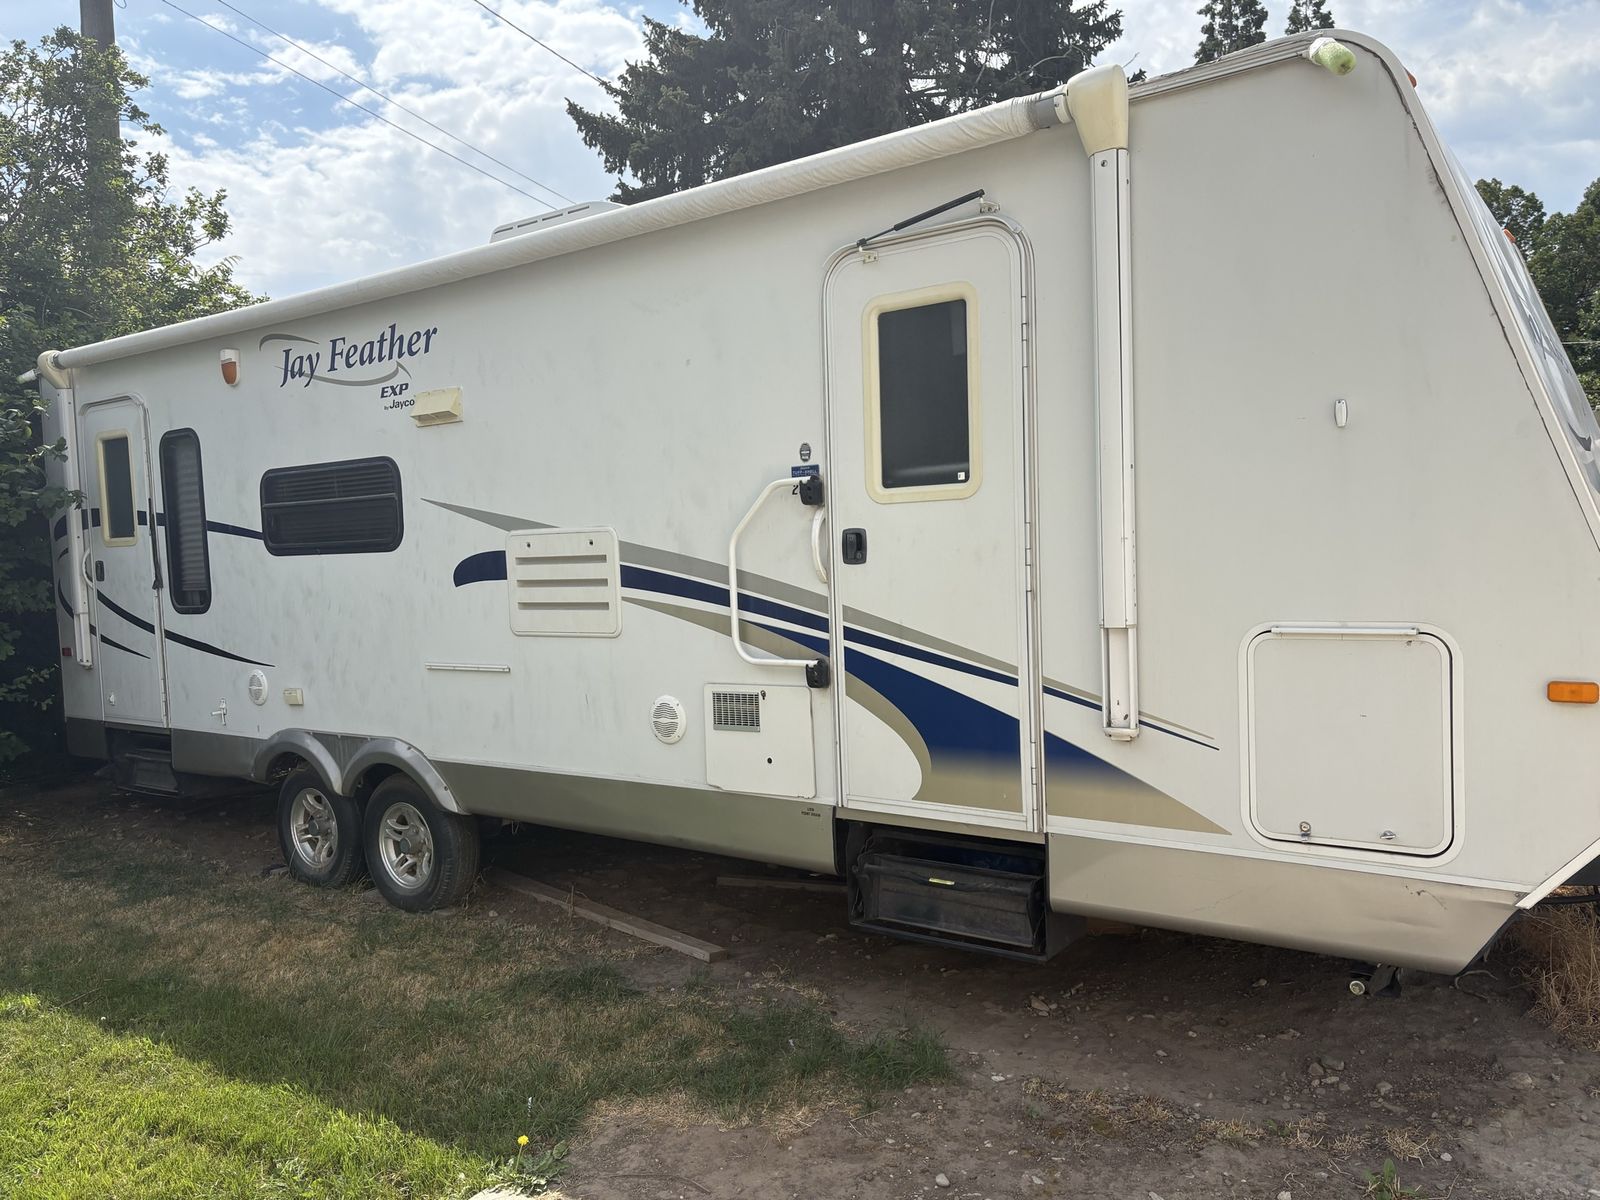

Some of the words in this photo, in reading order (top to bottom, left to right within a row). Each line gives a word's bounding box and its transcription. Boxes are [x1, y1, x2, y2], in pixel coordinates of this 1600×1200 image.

[280, 348, 320, 388] Jay
[327, 323, 438, 372] Feather
[380, 382, 409, 399] EXP
[389, 399, 415, 410] Jayco
